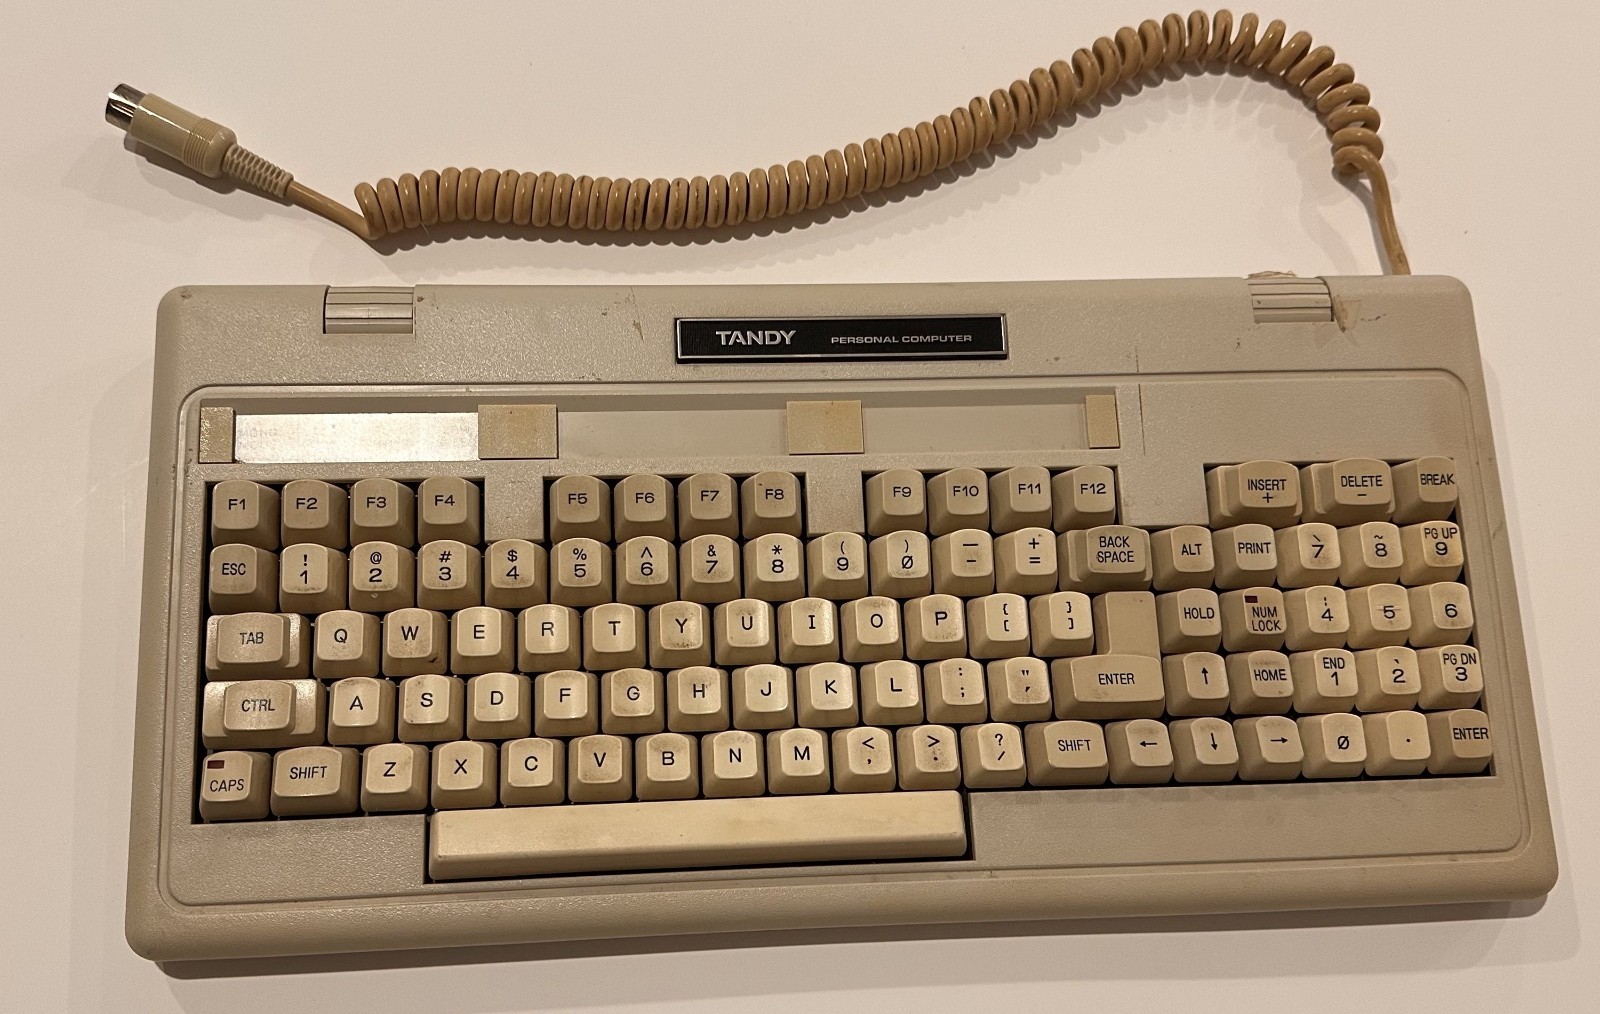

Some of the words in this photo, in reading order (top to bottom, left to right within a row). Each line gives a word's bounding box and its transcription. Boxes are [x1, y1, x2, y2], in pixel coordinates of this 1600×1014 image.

[716, 330, 797, 346] TANDY
[831, 335, 899, 345] PERSONAL
[902, 333, 972, 344] COMPUTER
[1248, 479, 1286, 490] INSERT
[1341, 475, 1382, 487] DELETE
[1421, 474, 1455, 485] BREAK
[766, 489, 784, 500] F8
[893, 487, 911, 497] F9
[953, 486, 979, 496] F10
[1019, 483, 1040, 494] F11
[1081, 483, 1106, 494] F12
[435, 495, 455, 506] F4
[569, 493, 587, 504] F5
[636, 493, 654, 503] F6
[701, 490, 719, 501] F7
[1263, 493, 1273, 503] +
[229, 499, 245, 510] F1
[297, 498, 317, 509] F2
[367, 497, 386, 508] F3
[1424, 528, 1438, 539] PG
[1441, 528, 1457, 539] UP
[1029, 538, 1039, 549] +
[1099, 536, 1130, 547] BACK
[1238, 542, 1271, 554] PRINT
[573, 548, 587, 560] %
[708, 545, 716, 557] &
[1182, 544, 1202, 555] ALT
[1312, 545, 1324, 558] 7
[1375, 543, 1387, 557] 8
[1436, 542, 1447, 555] 9
[370, 552, 382, 564] @
[439, 551, 452, 562] #
[508, 549, 517, 562] $
[1030, 556, 1040, 564] =
[1097, 551, 1134, 563] SPACE
[222, 563, 246, 575] ESC
[575, 564, 586, 577] 5
[641, 562, 653, 576] 6
[706, 560, 718, 574] 7
[772, 559, 784, 573] 8
[837, 557, 848, 571] 9
[300, 570, 307, 584] 1
[369, 568, 382, 582] 2
[439, 567, 451, 581] 3
[506, 566, 519, 580] 4
[1002, 604, 1009, 615] {
[1065, 602, 1072, 613] }
[1184, 607, 1214, 619] HOLD
[1252, 607, 1277, 618] NUM
[1383, 606, 1395, 619] 5
[1445, 604, 1457, 618] 6
[871, 614, 883, 628] O
[935, 611, 947, 625] P
[1322, 608, 1333, 621] 4
[608, 621, 620, 635] T
[675, 618, 687, 633] Y
[742, 616, 752, 630] U
[808, 615, 815, 629] I
[1003, 620, 1010, 631] [
[1067, 618, 1075, 629] ]
[1252, 620, 1281, 631] LOCK
[401, 626, 418, 640] W
[474, 625, 485, 639] E
[542, 622, 553, 636] R
[240, 632, 263, 644] TAB
[334, 629, 347, 643] Q
[1323, 657, 1345, 669] END
[1443, 654, 1457, 665] PG
[1461, 653, 1476, 665] DN
[1099, 673, 1135, 685] ENTER
[1254, 669, 1287, 681] HOME
[1331, 672, 1338, 685] 1
[1393, 669, 1405, 683] 2
[1456, 667, 1467, 681] 3
[693, 684, 705, 698] H
[761, 682, 771, 696] J
[825, 680, 837, 694] K
[891, 678, 902, 692] L
[491, 691, 503, 705] D
[560, 688, 571, 702] F
[627, 686, 639, 700] G
[242, 699, 275, 712] CTRL
[350, 696, 363, 710] A
[421, 693, 433, 707] S
[995, 734, 1003, 745] ?
[1453, 728, 1488, 740] ENTER
[862, 738, 874, 749] <
[927, 736, 940, 747] >
[1058, 740, 1090, 751] SHIFT
[662, 751, 674, 765] B
[730, 748, 741, 763] N
[794, 746, 810, 760] M
[997, 751, 1006, 760] /
[454, 759, 467, 774] X
[525, 756, 538, 771] C
[594, 753, 606, 767] V
[290, 766, 327, 779] SHIFT
[383, 762, 396, 777] Z
[210, 779, 244, 792] CAPS
